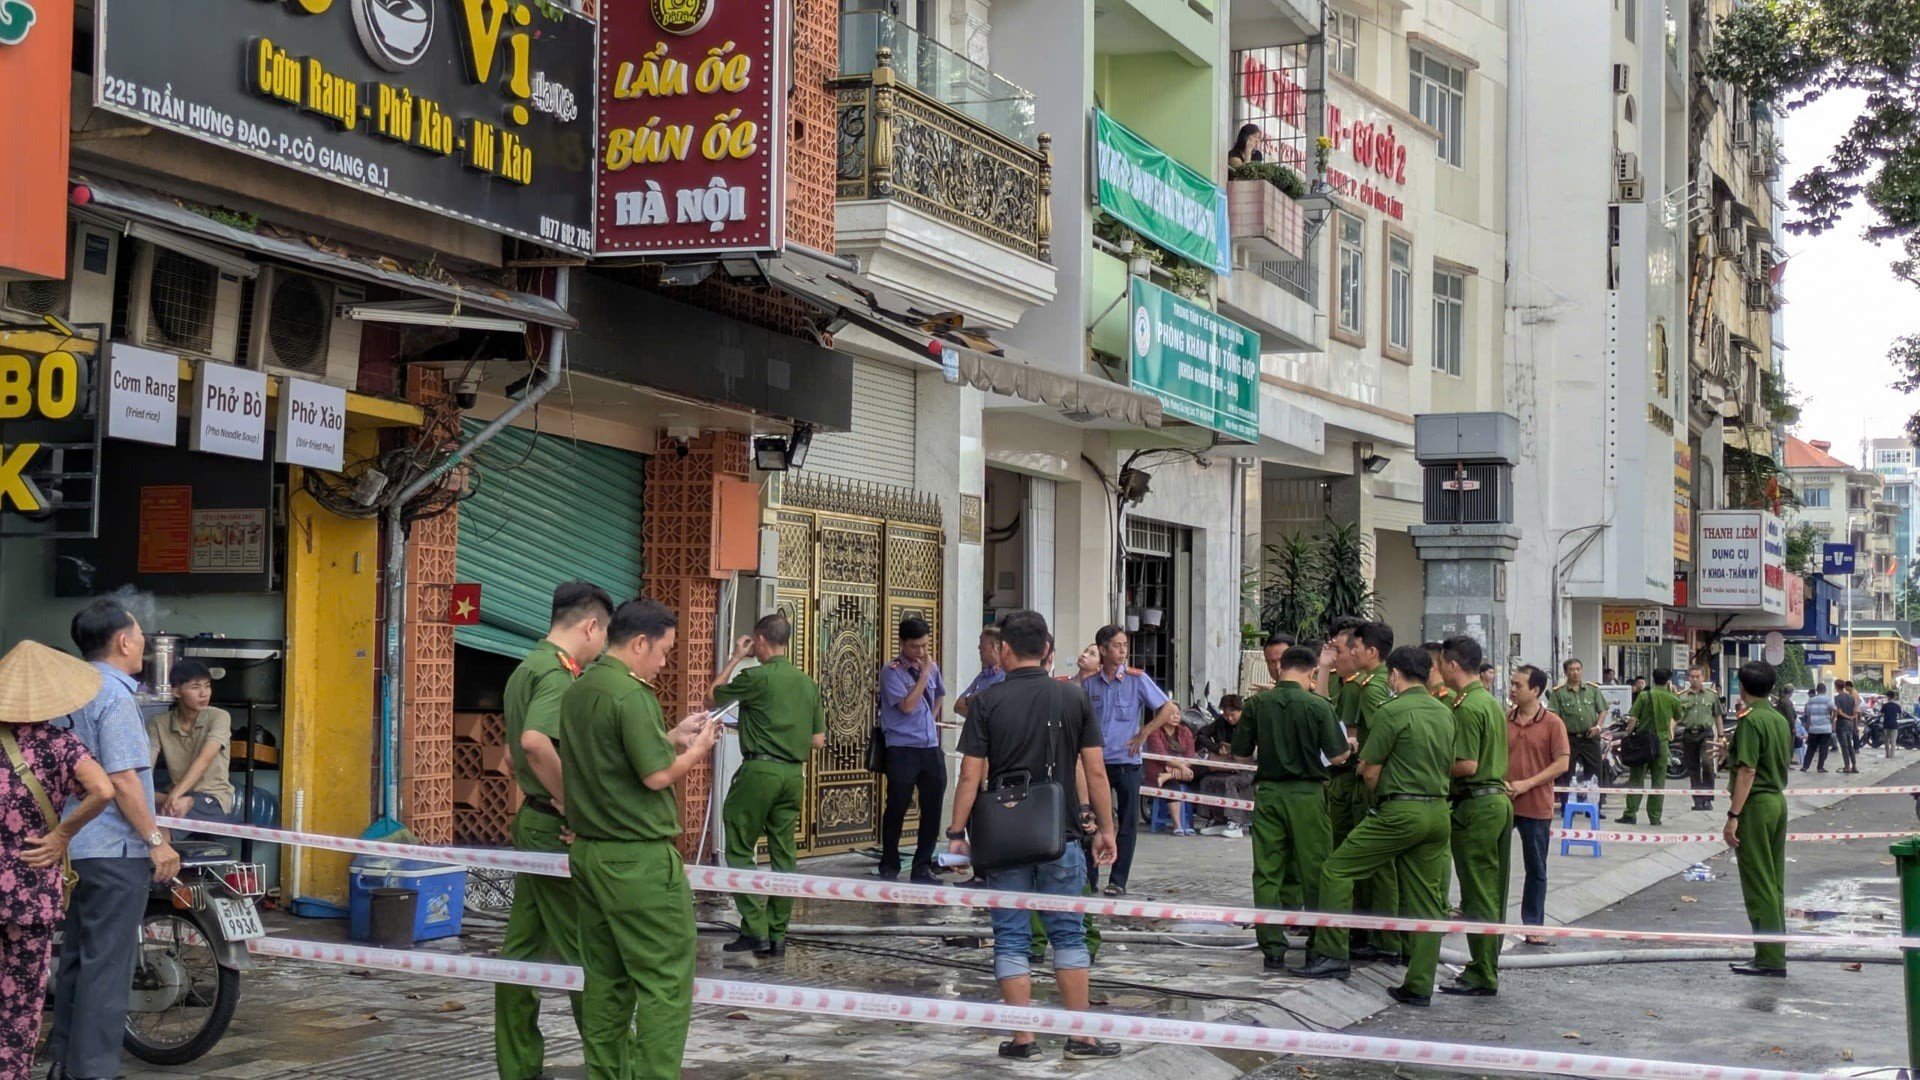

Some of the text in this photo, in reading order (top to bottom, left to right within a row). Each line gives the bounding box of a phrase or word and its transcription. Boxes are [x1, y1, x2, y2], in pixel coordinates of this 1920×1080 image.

[613, 40, 751, 99] LẨU ỐC
[259, 38, 301, 103] Cơm
[310, 58, 356, 130] Rang
[380, 83, 412, 142] Phở
[419, 97, 453, 155] Xào
[473, 120, 494, 172] Mì
[502, 131, 532, 185] Xào
[105, 76, 136, 105] 225
[142, 83, 185, 122] TRẦN
[189, 105, 234, 138] HƯNG
[318, 147, 364, 185] GIANG,
[367, 162, 389, 188] Q.1
[605, 108, 758, 171] BÚN ỐC
[1353, 120, 1374, 168] CƠ
[1375, 124, 1395, 179] SỞ
[1396, 145, 1406, 186] 2
[615, 176, 747, 233] HÀ NỘI
[540, 215, 560, 240] 0977
[576, 227, 591, 250] 795
[1157, 320, 1184, 352] PHÒNG
[1186, 333, 1207, 362] KHÁM
[114, 369, 176, 403] Cơm Rang
[207, 384, 262, 418] Phở Bò
[291, 399, 343, 430] Phở Xào
[1703, 527, 1733, 539] THANH
[1702, 568, 1707, 579] Y
[1708, 568, 1725, 579] KHOA
[1729, 564, 1748, 579] THẨM
[1749, 566, 1759, 579] MỸ
[1712, 548, 1735, 561] DỤNG
[1738, 548, 1749, 561] CỤ
[229, 917, 258, 936] 9936
